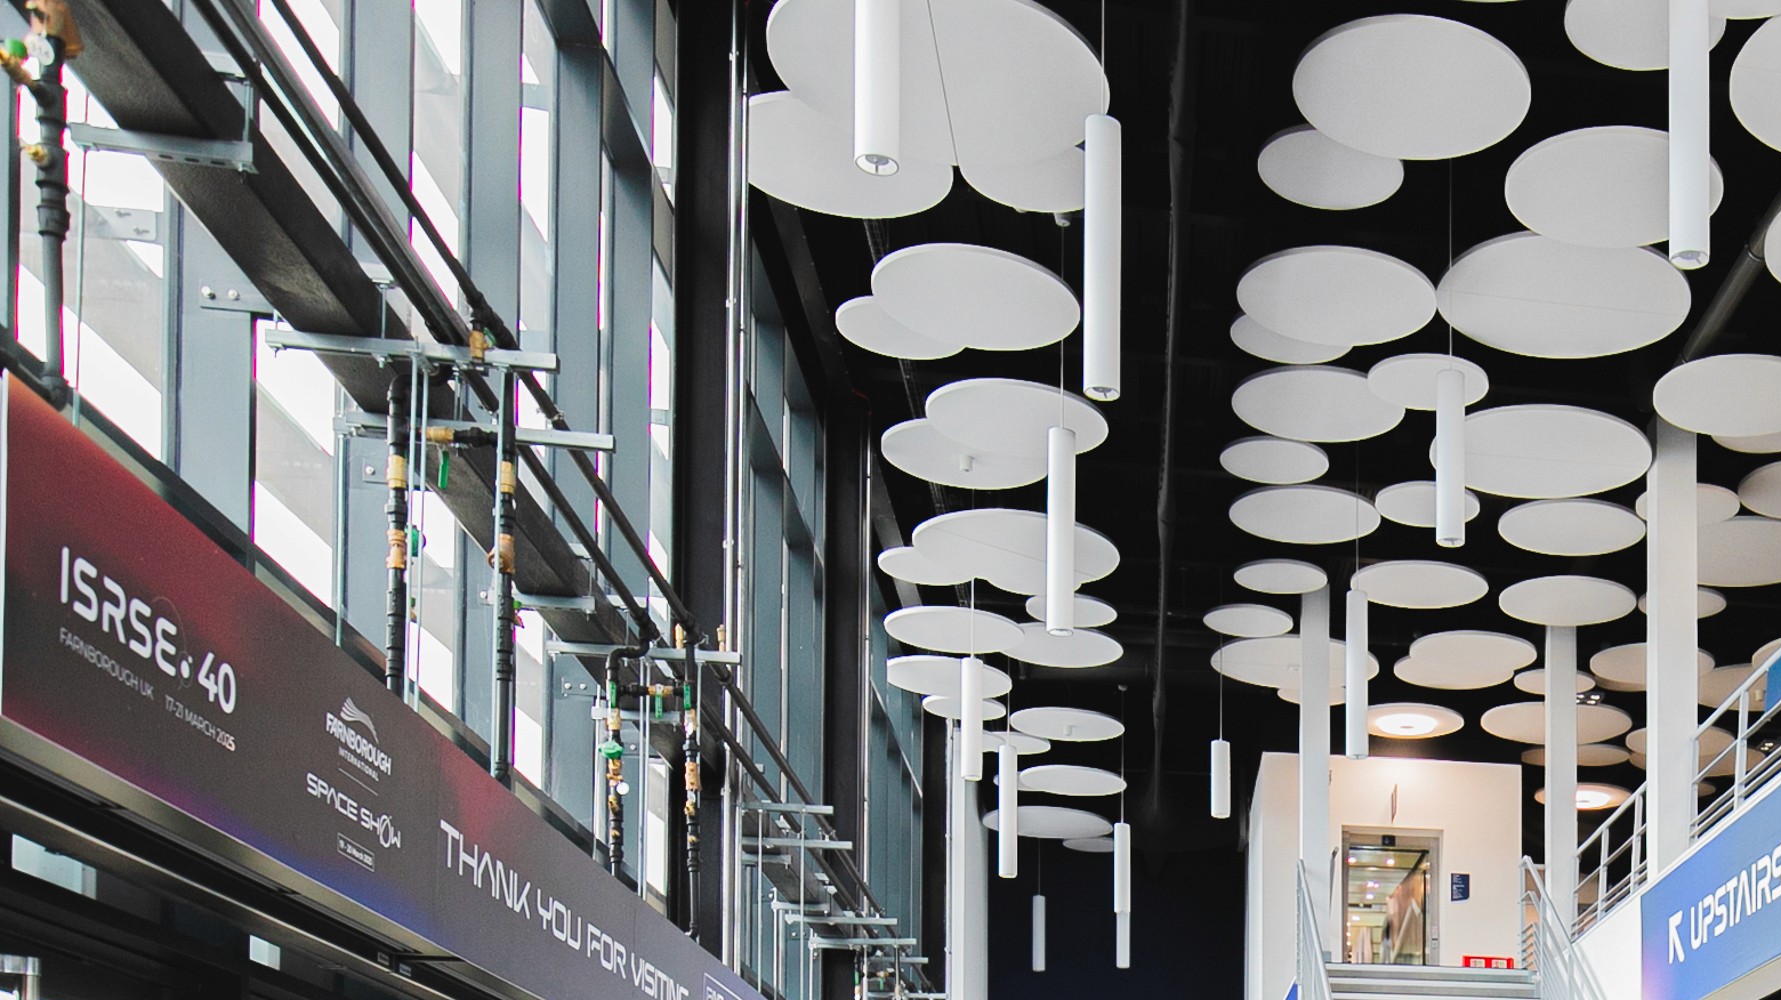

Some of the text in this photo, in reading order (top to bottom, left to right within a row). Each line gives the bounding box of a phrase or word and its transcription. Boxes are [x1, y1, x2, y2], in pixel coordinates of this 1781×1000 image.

[60, 627, 139, 692] FARNBOROUGH
[140, 679, 154, 700] UK
[185, 708, 216, 740] MARCH
[198, 652, 236, 714] 40
[326, 712, 391, 776] FARNBOROUGH
[306, 772, 401, 848] SPACE SHOW
[440, 819, 531, 920] THANK
[537, 888, 582, 951] YOU
[587, 923, 627, 980] FOR
